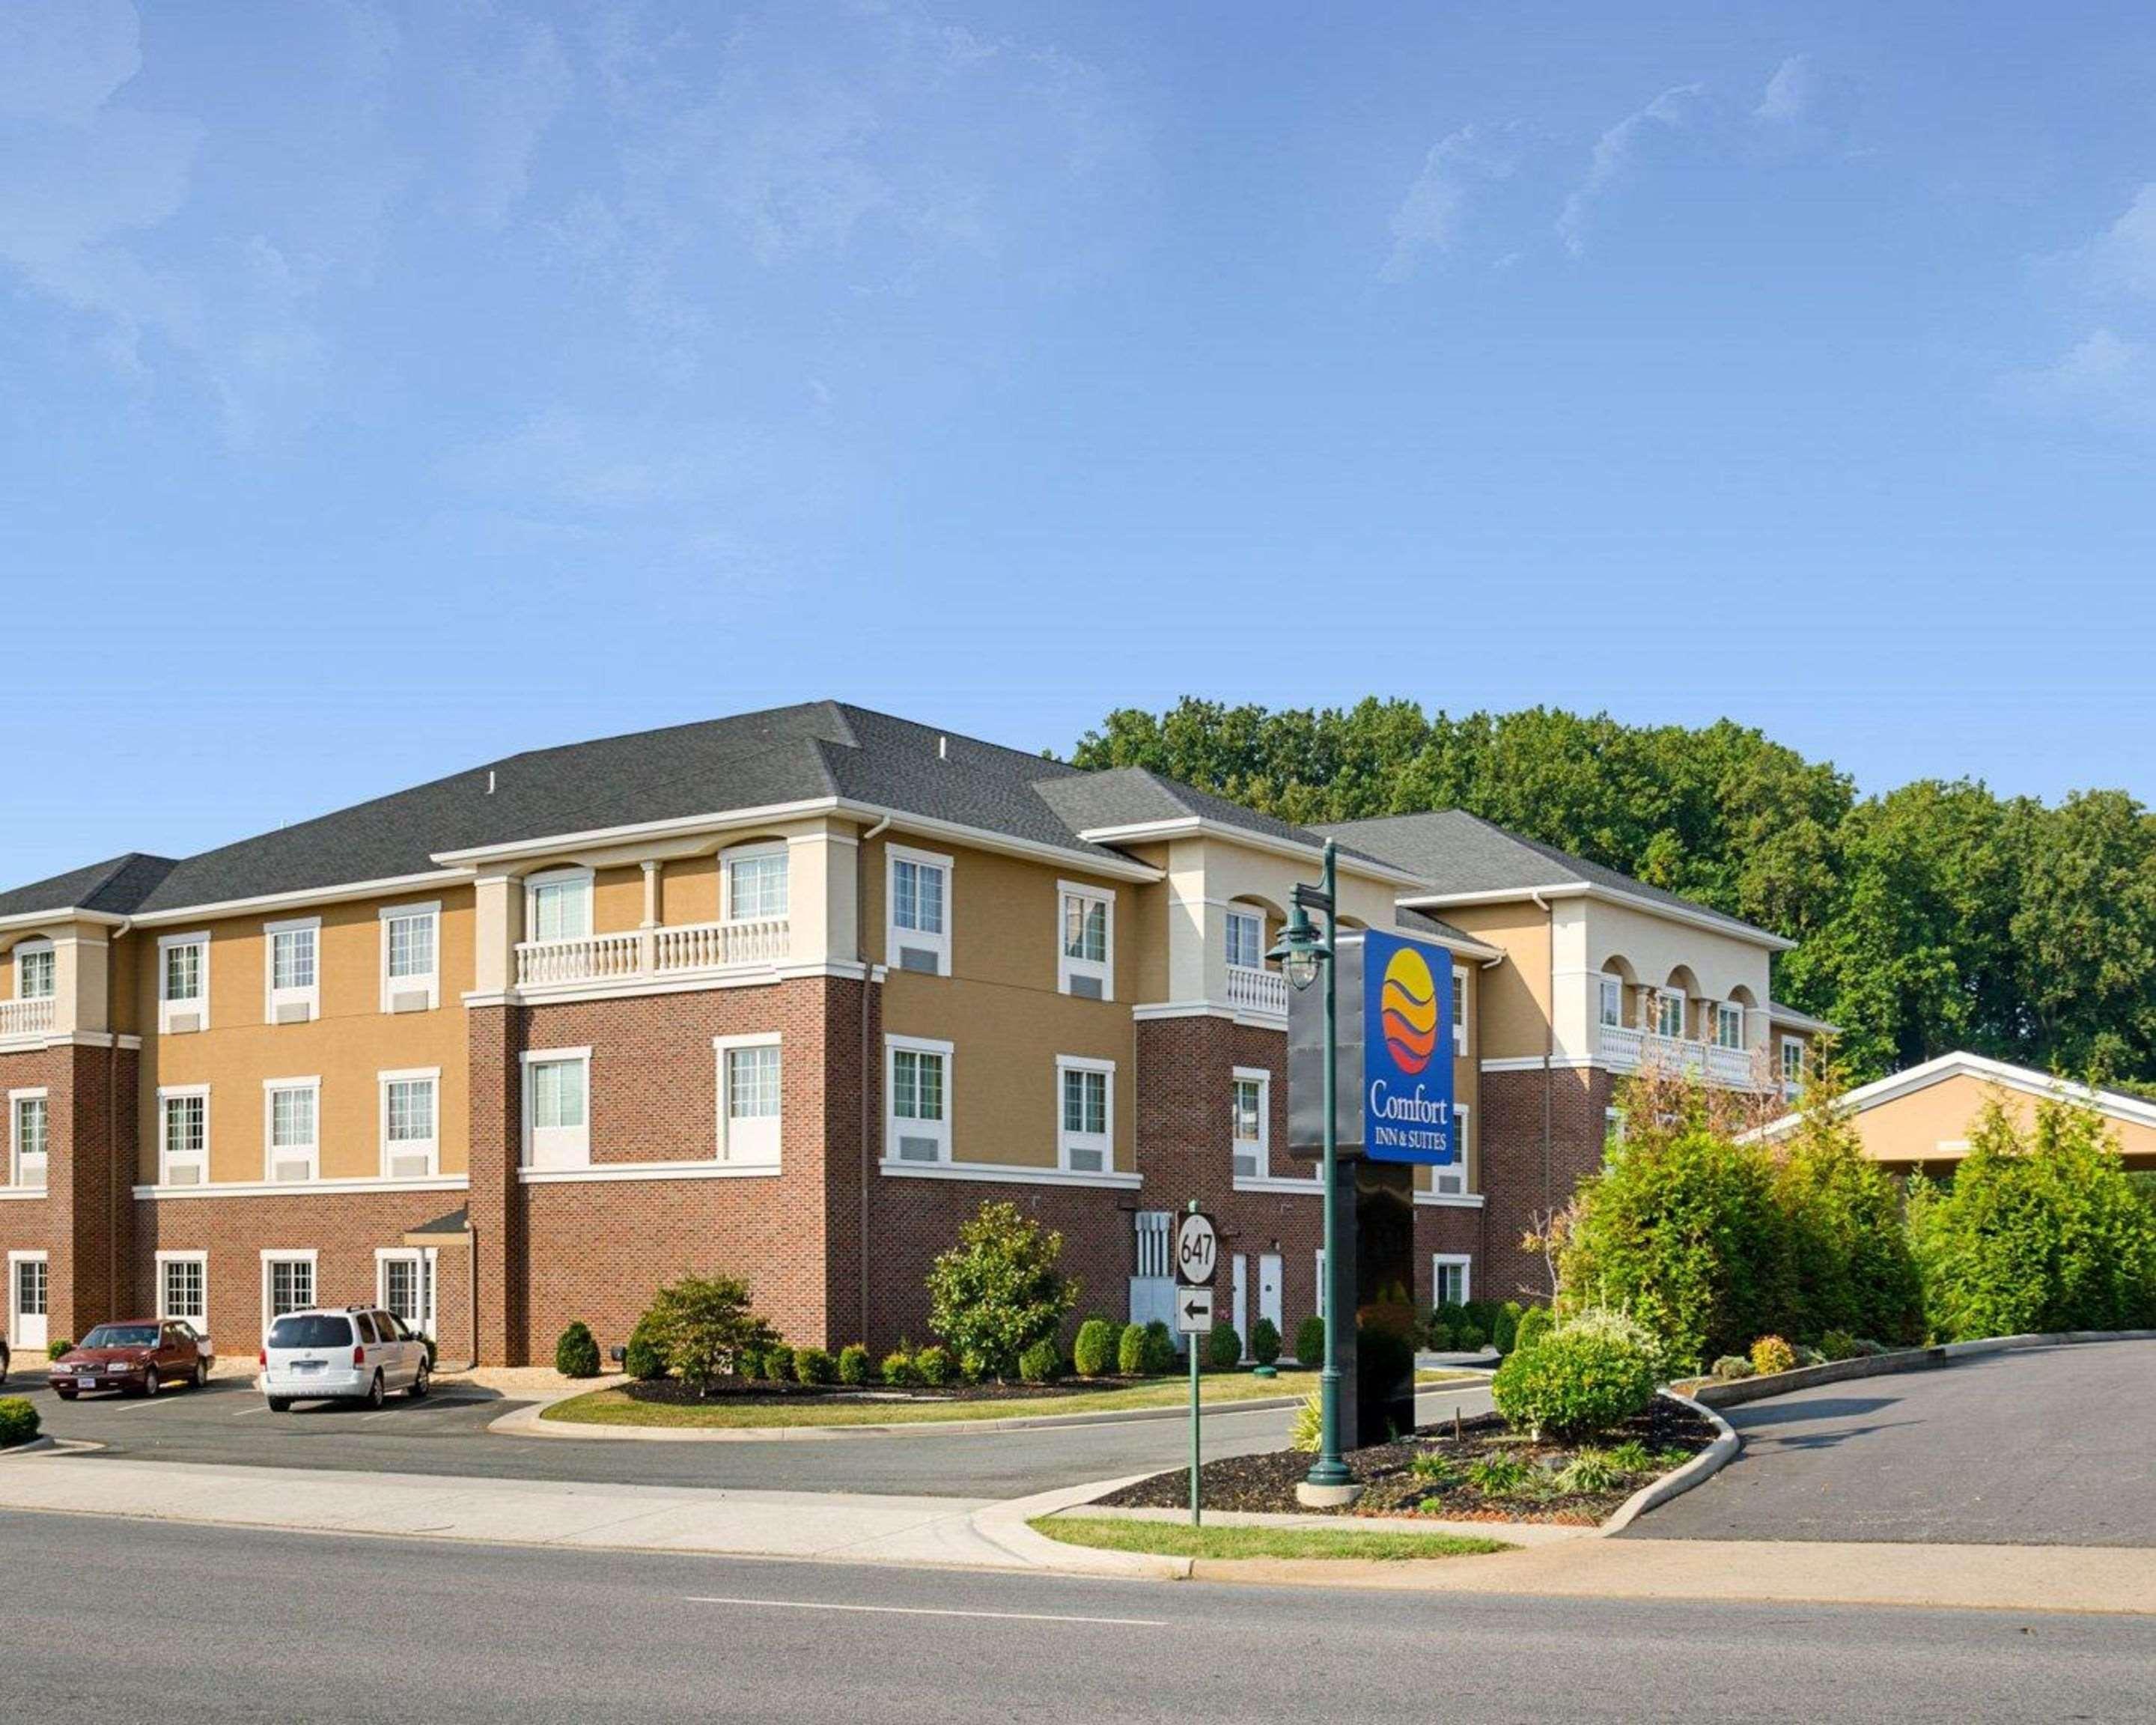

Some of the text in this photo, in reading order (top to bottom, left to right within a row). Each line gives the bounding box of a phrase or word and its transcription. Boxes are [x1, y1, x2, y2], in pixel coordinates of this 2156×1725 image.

[1371, 1079, 1448, 1125] Comfort
[1375, 1126, 1446, 1151] INN & SUITES
[1181, 1233, 1212, 1265] 647
